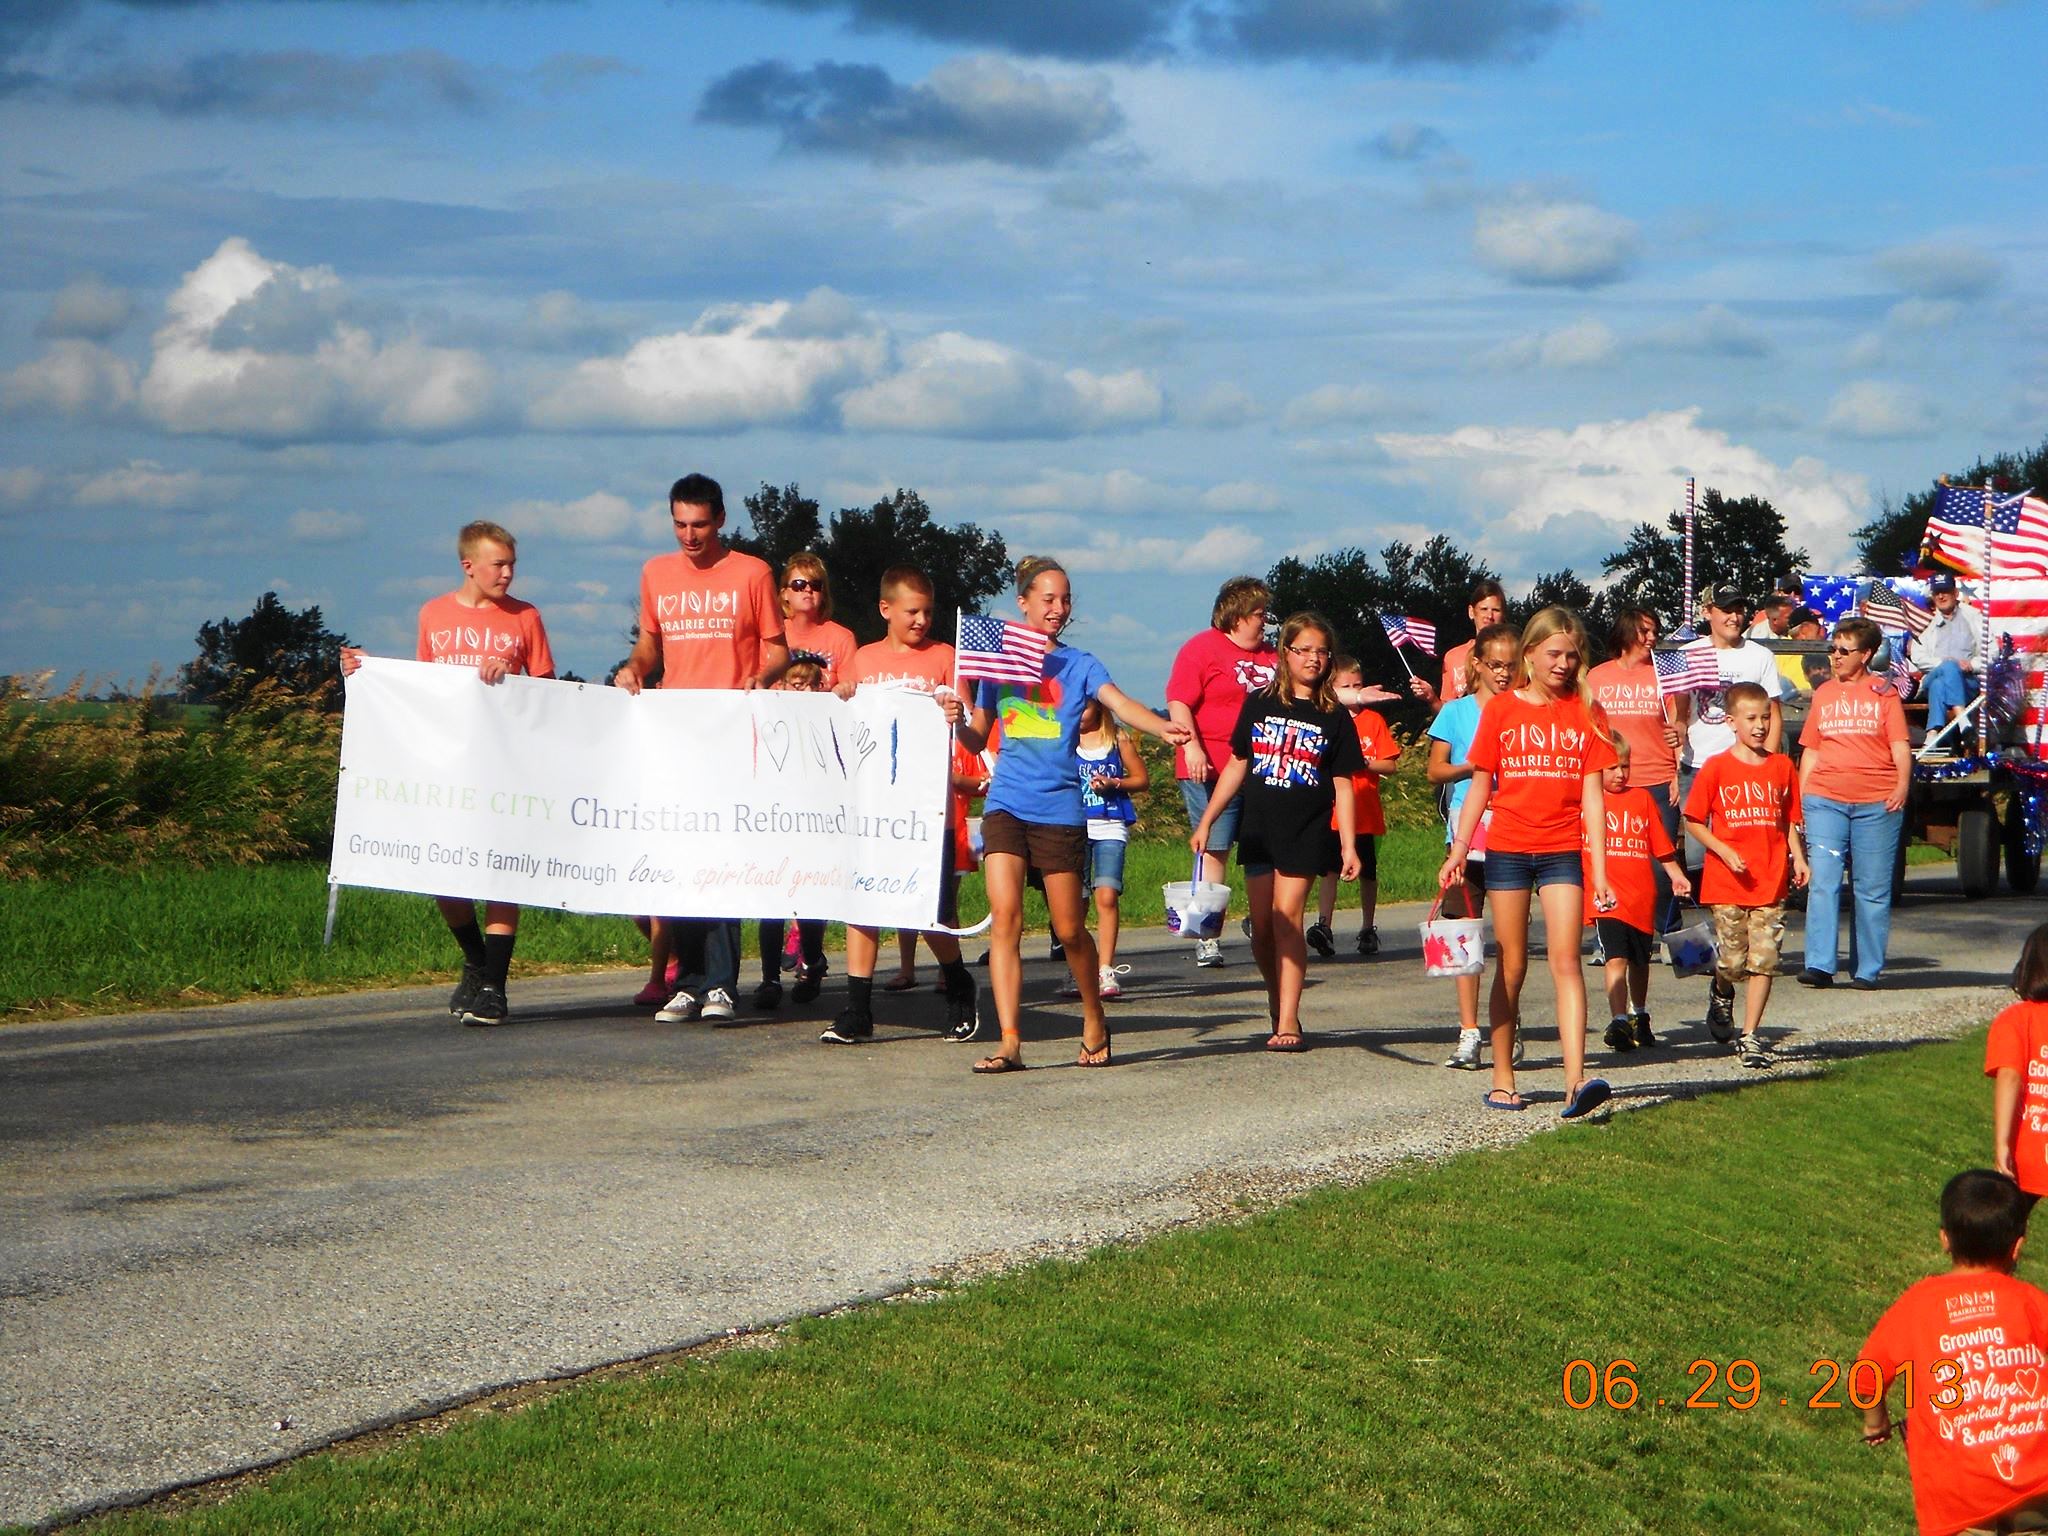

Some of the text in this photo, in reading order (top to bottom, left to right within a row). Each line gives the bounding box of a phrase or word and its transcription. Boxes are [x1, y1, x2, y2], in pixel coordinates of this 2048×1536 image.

[660, 618, 735, 633] PRAIRIE CITY
[1601, 700, 1659, 709] RAIRIE CITY
[1856, 718, 1878, 729] CITY
[1501, 754, 1551, 768] PRAIRIE
[1264, 776, 1291, 788] 2013
[355, 776, 928, 842] PRAIRIE CITY Christian Reformed urch
[1725, 806, 1769, 820] PRAIRIE
[349, 833, 421, 865] Growing
[427, 842, 480, 867] God's
[486, 848, 541, 878] family
[546, 857, 617, 886] through
[692, 856, 790, 896] spiritual
[1949, 1306, 1976, 1319] PRAIRIE
[1979, 1304, 1995, 1313] CITY
[1939, 1326, 2004, 1353] Growing
[1986, 1343, 2045, 1368] family
[1953, 1397, 2007, 1432] spiritual
[1962, 1426, 1977, 1446] &
